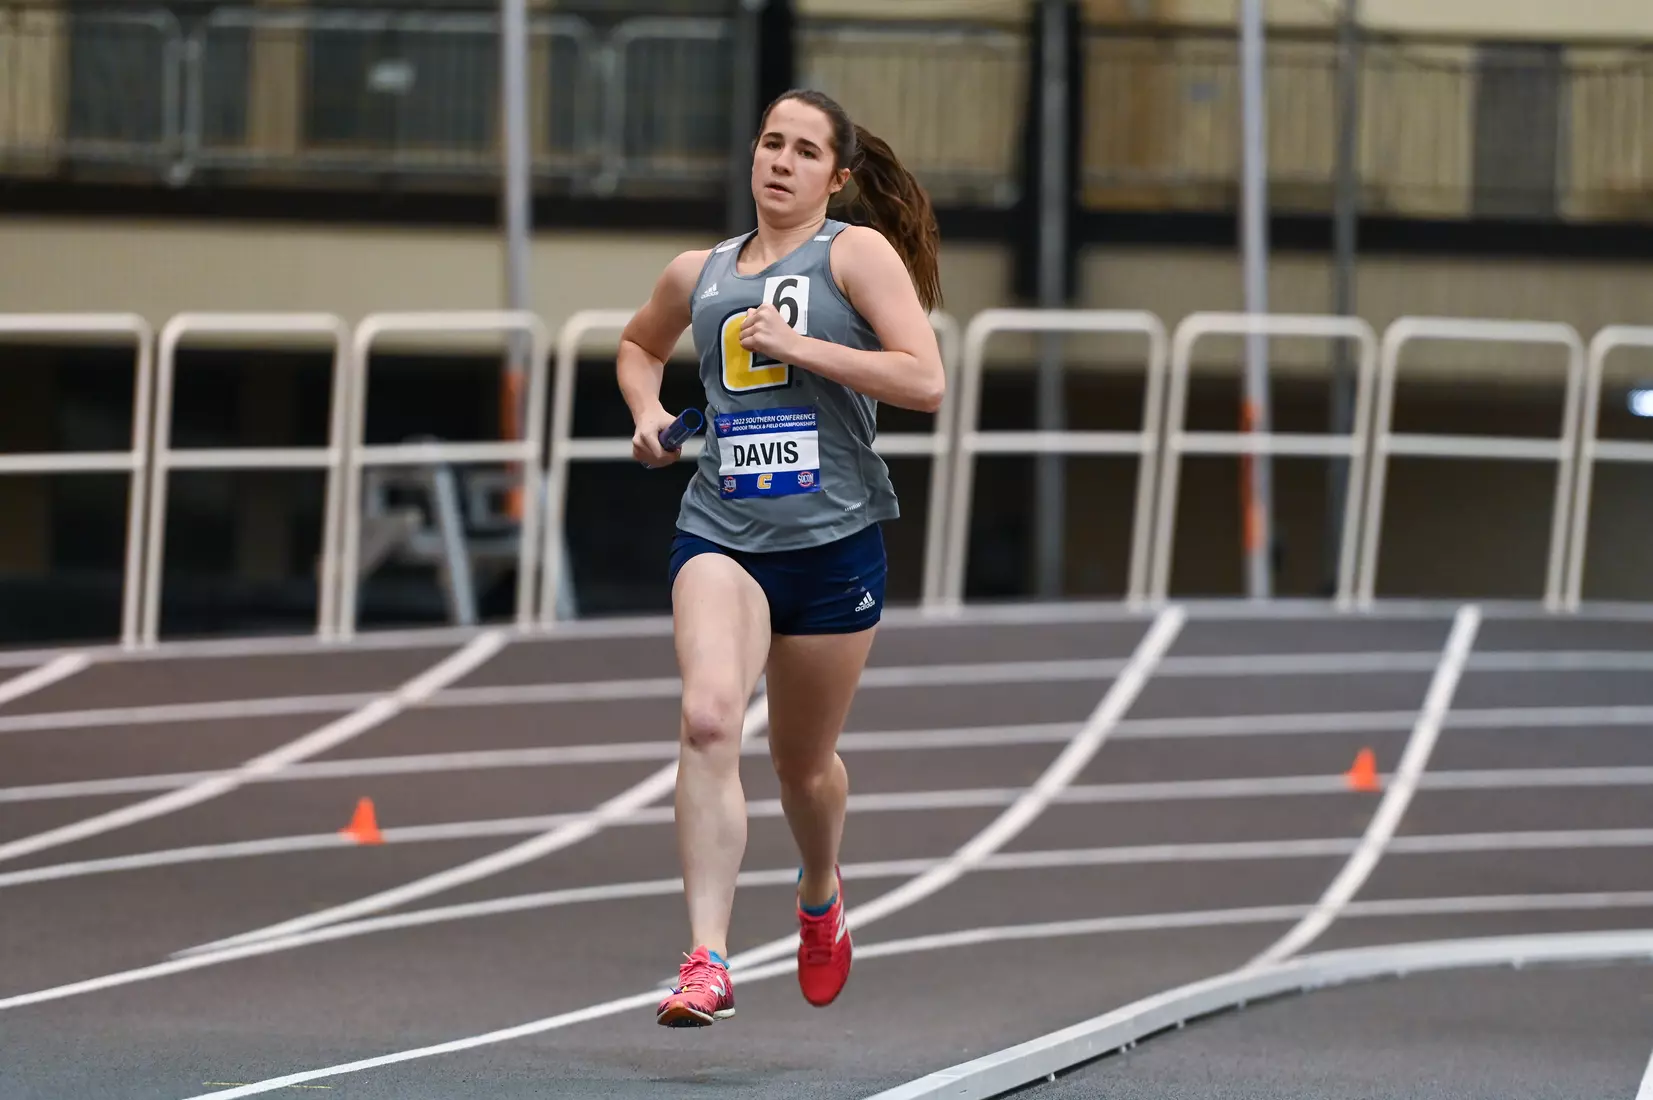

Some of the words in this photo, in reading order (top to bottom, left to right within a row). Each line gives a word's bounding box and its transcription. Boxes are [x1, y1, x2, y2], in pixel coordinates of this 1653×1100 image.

[772, 278, 799, 329] 6
[745, 415, 776, 424] SOUTHERN
[776, 413, 816, 422] CONFERENCE
[733, 441, 799, 467] DAVIS
[756, 473, 773, 490] C
[797, 473, 814, 484] SOCON
[854, 600, 876, 612] adidas
